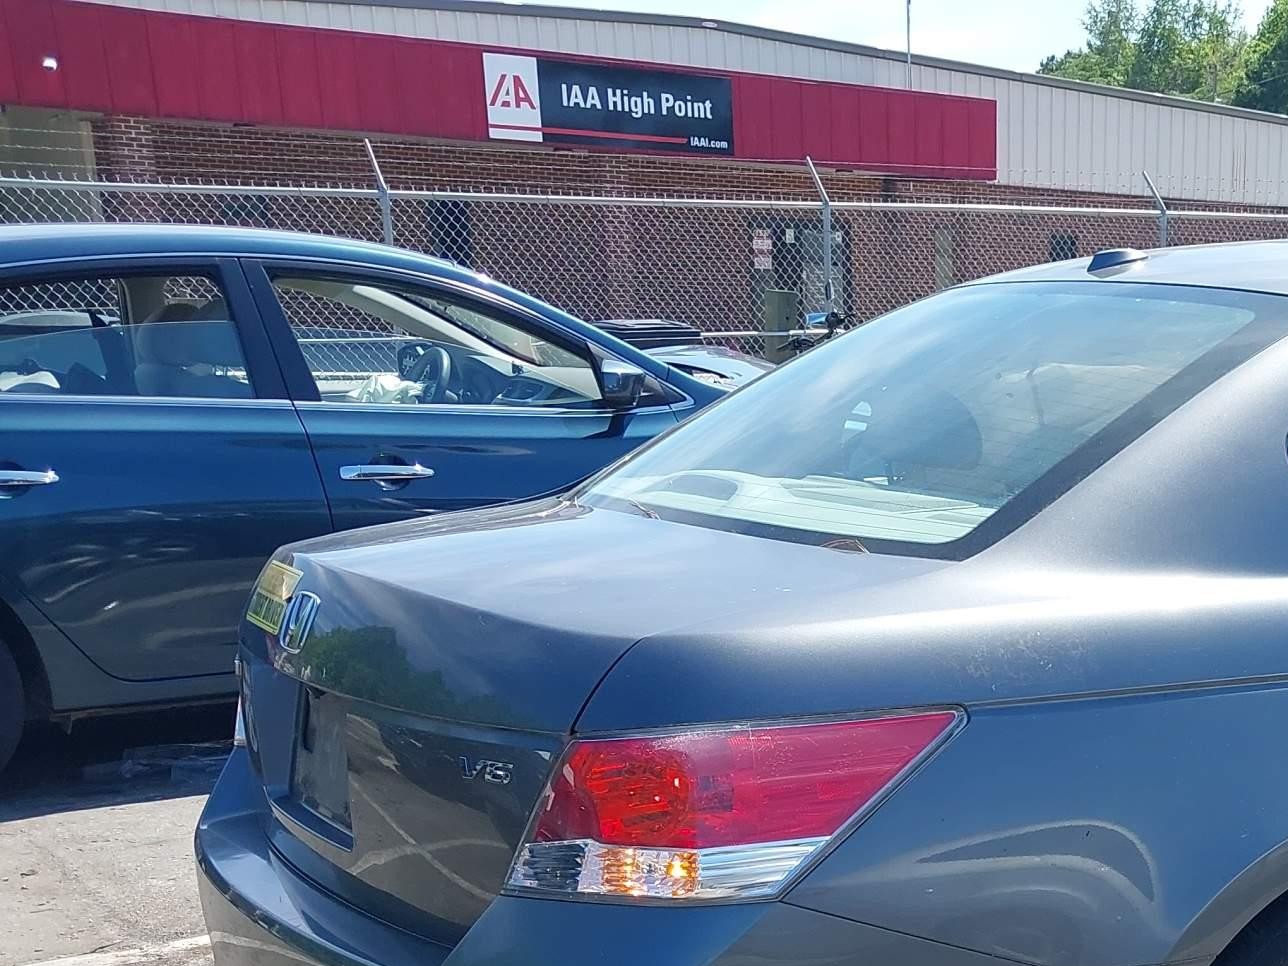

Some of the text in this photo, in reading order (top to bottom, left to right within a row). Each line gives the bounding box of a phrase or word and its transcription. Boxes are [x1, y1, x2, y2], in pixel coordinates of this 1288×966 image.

[561, 83, 713, 120] IAA High Point
[690, 136, 728, 149] IAAI.com
[459, 756, 514, 784] V6
